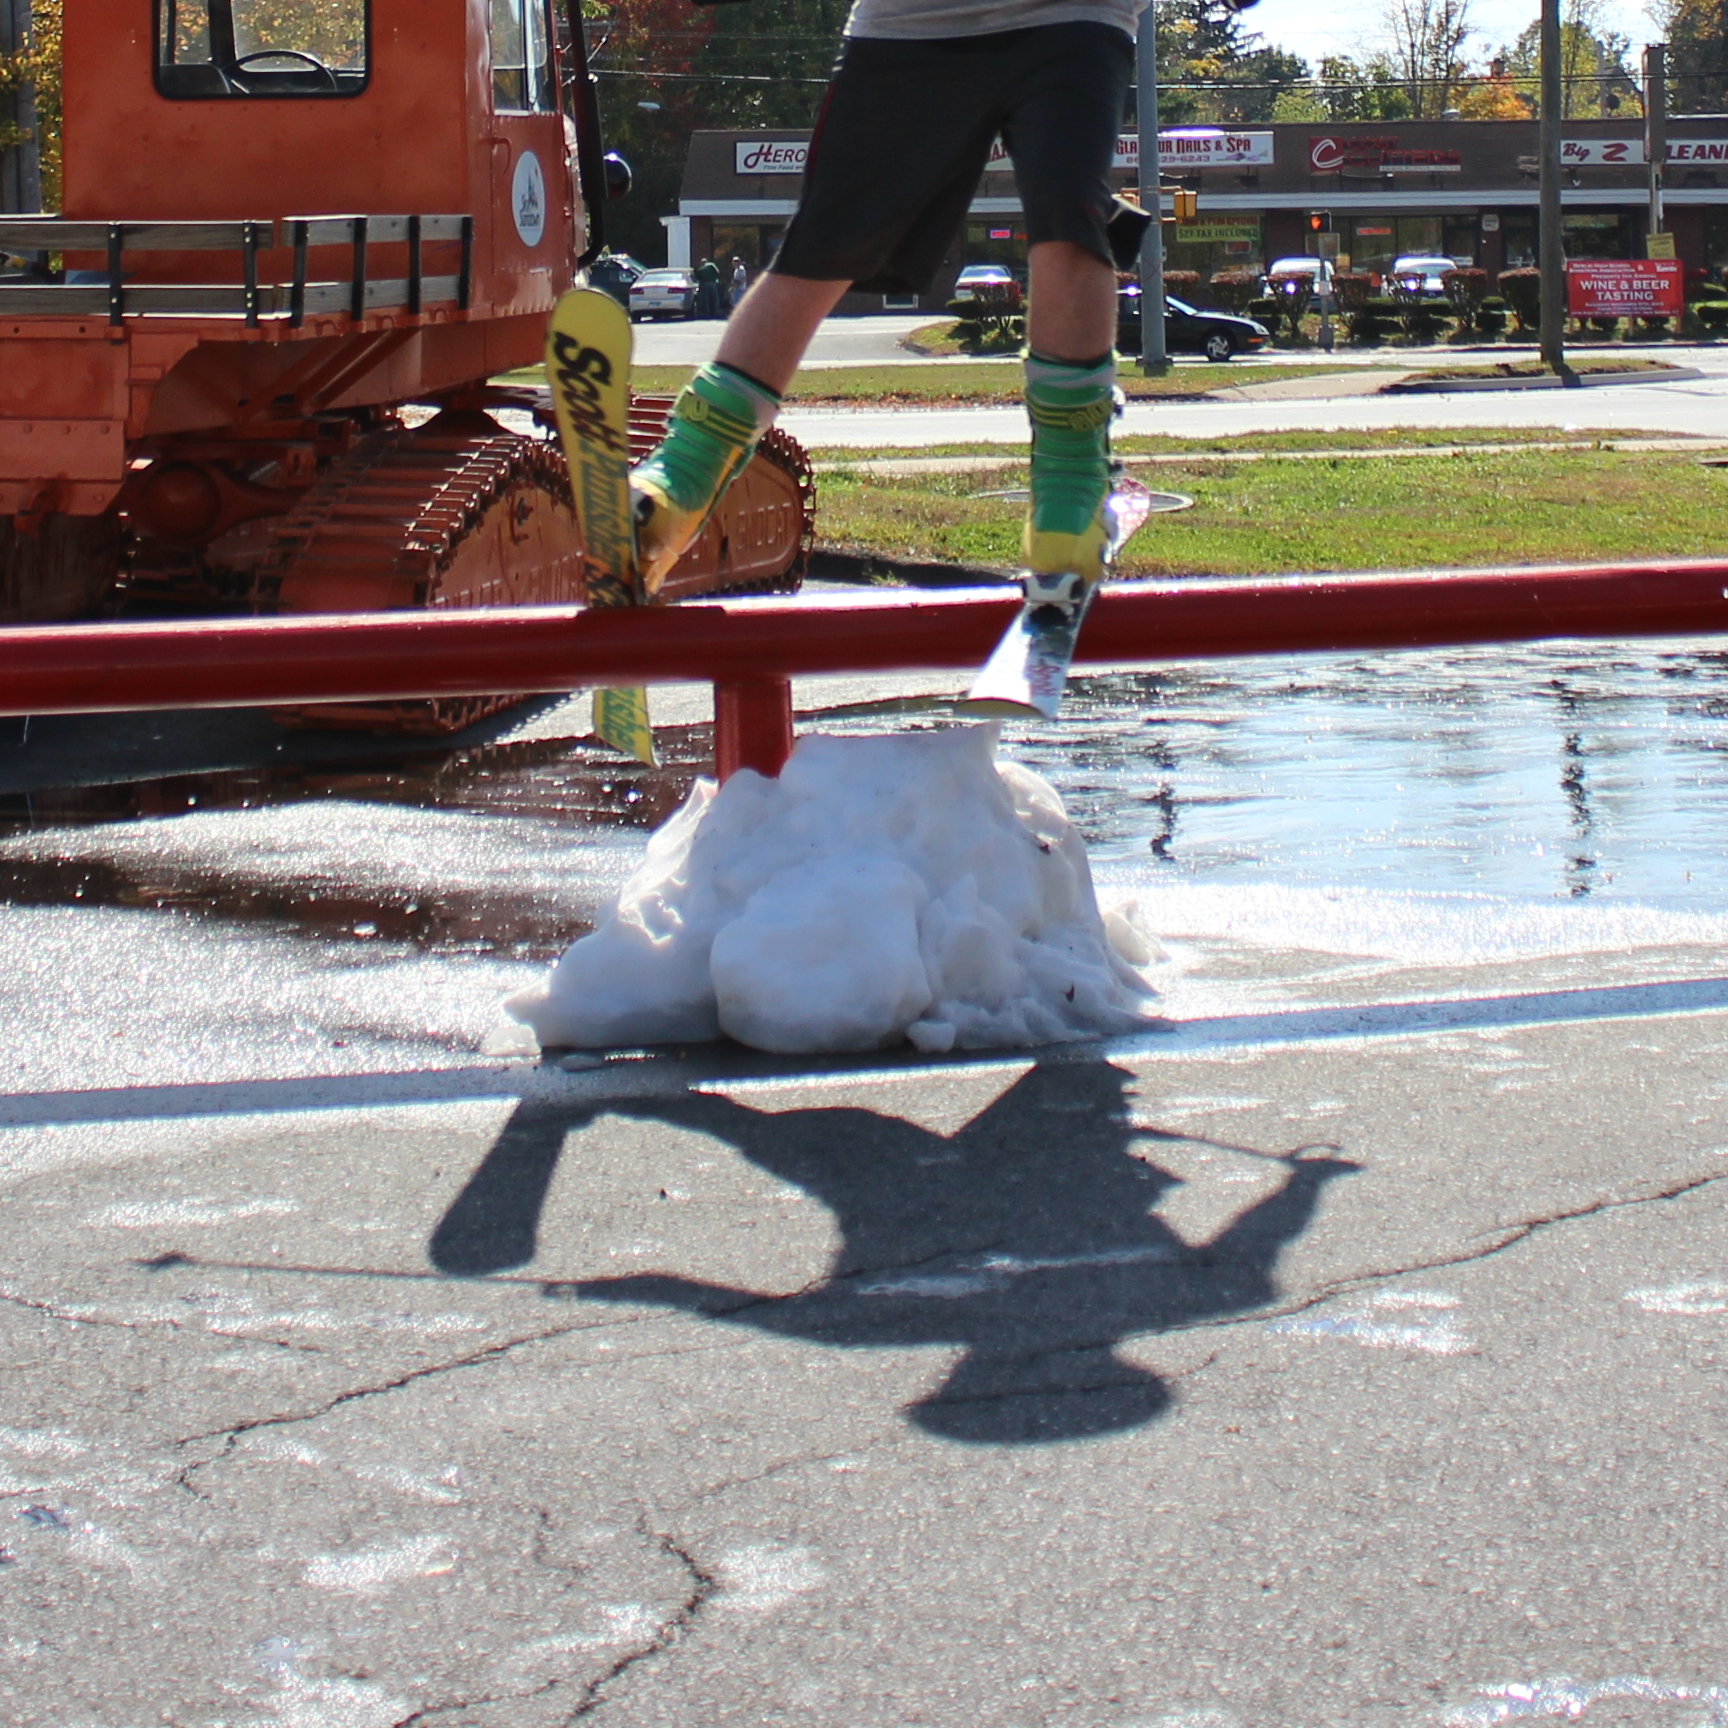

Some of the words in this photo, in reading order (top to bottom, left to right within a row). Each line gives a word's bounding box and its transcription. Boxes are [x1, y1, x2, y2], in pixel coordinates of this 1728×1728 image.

[1116, 139, 1172, 155] GLAUR
[1176, 138, 1211, 153] NAILS
[1215, 140, 1223, 151] &
[1226, 136, 1251, 153] SPA
[1562, 142, 1591, 162] Big
[1196, 230, 1212, 238] TAX
[1580, 280, 1617, 290] WINE
[1619, 280, 1630, 290] &
[1632, 280, 1670, 290] BEER
[1596, 291, 1655, 301] TASTING
[551, 330, 626, 454] Scott
